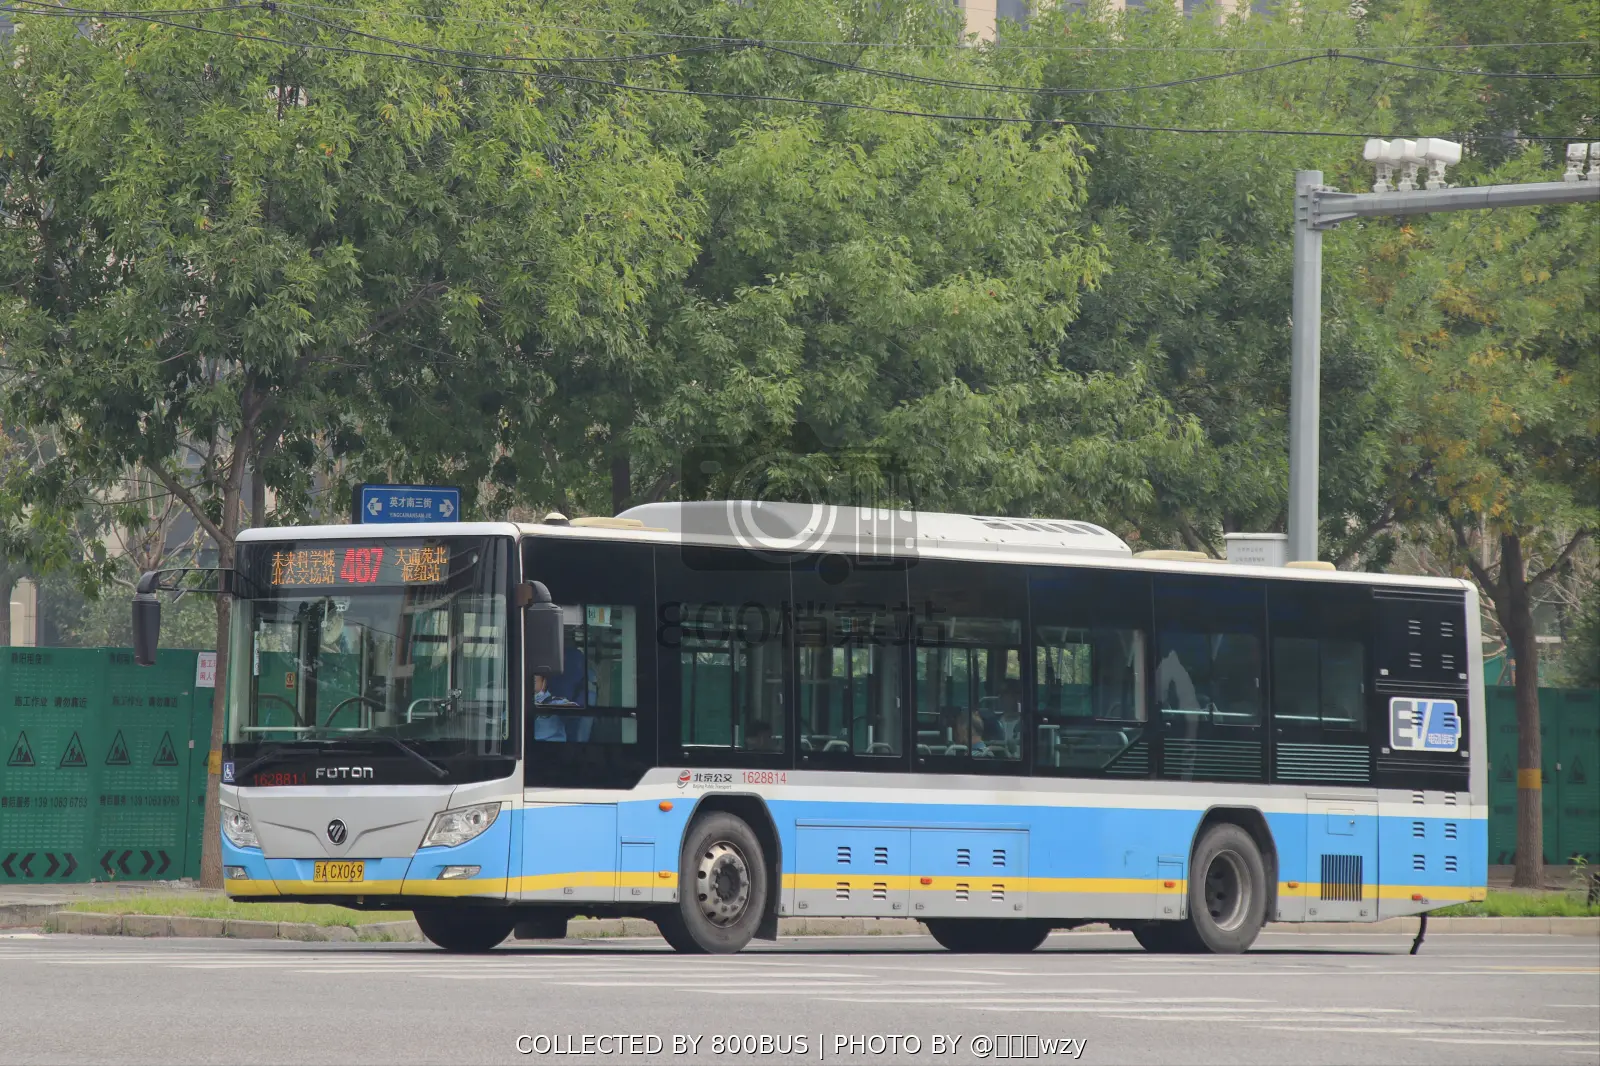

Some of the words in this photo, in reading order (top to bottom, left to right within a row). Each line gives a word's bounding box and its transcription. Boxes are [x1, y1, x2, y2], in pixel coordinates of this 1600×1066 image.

[390, 496, 432, 509] 英才南三街
[271, 549, 336, 568] 未来科学城
[394, 546, 447, 566] 天通苑北
[339, 547, 384, 583] 487
[271, 567, 336, 585] 北公交场站
[401, 564, 441, 582] 枢纽站
[199, 671, 216, 681] 闲人
[14, 696, 48, 707] 施工作业
[54, 696, 88, 708] 请勿靠近
[112, 695, 143, 706] 施工作业
[253, 772, 307, 786] 1628814
[315, 766, 374, 779] FOTON
[694, 773, 733, 783] 北京公交
[742, 771, 787, 784] 1628814
[34, 796, 48, 808] 139
